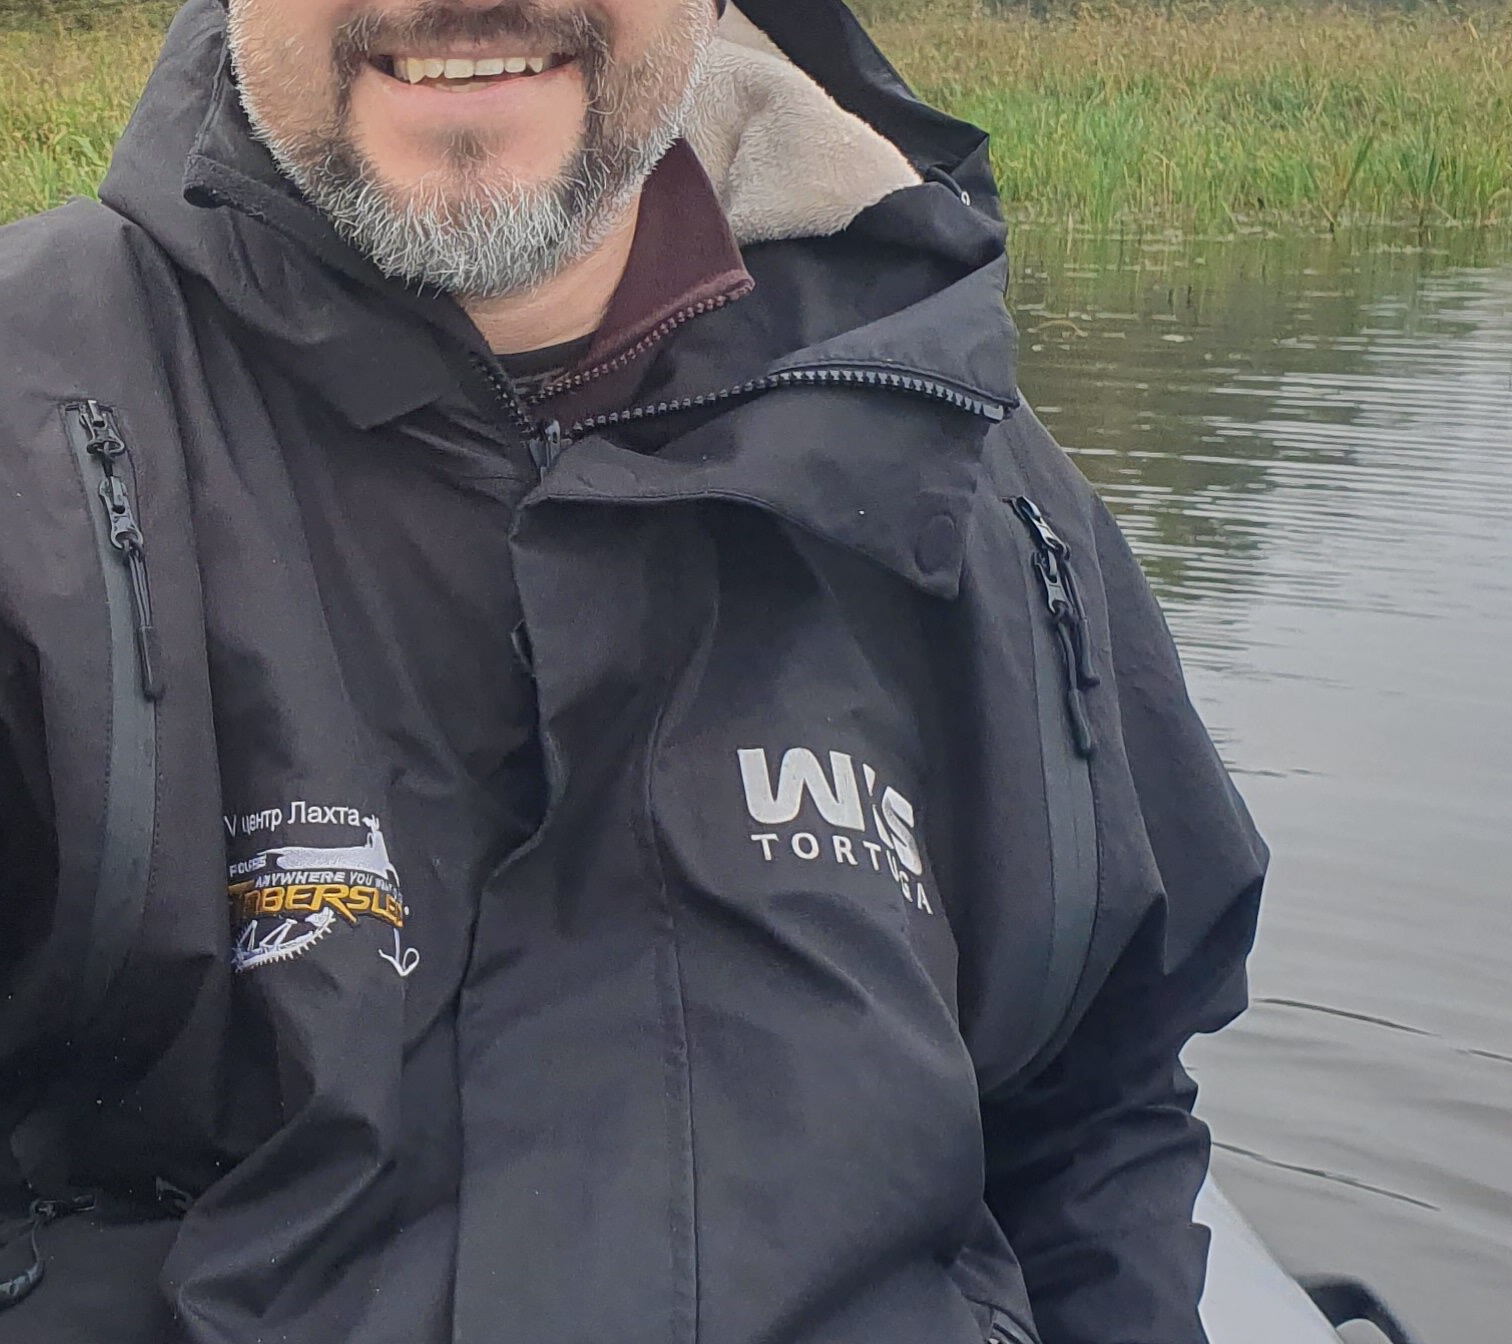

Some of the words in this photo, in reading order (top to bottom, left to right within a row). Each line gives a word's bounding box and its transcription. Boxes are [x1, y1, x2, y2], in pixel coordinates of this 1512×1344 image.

[242, 808, 282, 835] центр
[288, 801, 360, 827] Лахта
[255, 871, 346, 888] ANYWHERE
[349, 871, 373, 886] YOU
[751, 832, 934, 915] TORTUGA
